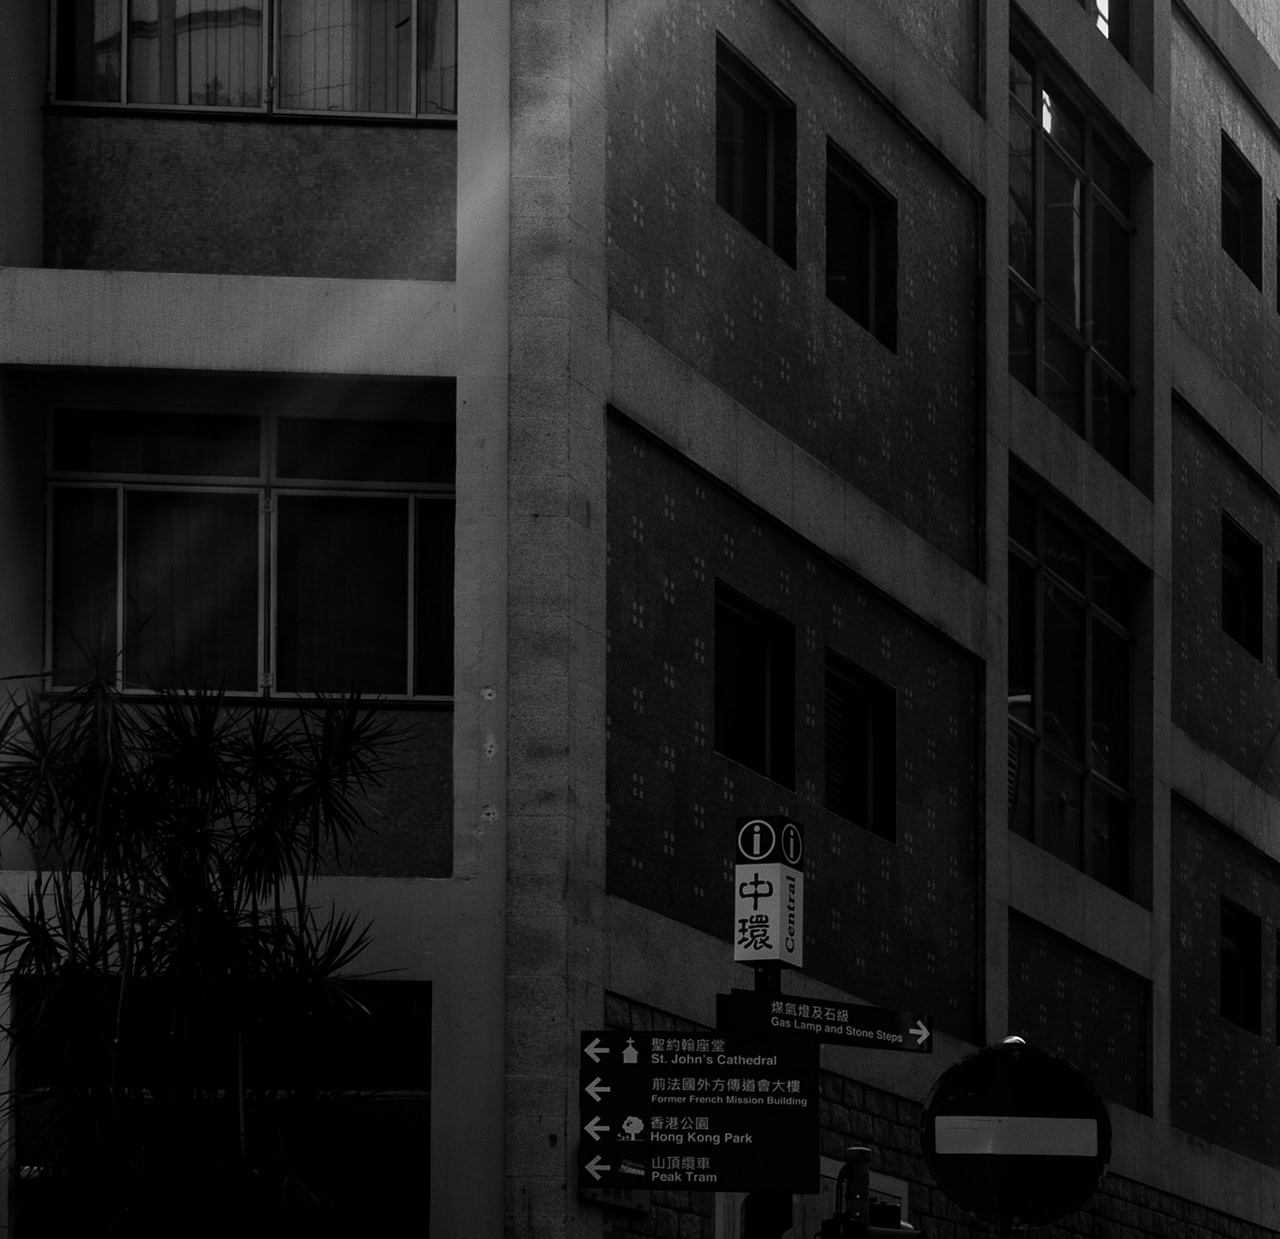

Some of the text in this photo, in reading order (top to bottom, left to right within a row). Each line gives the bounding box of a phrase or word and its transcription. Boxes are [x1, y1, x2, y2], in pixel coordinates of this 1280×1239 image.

[738, 873, 773, 950] 中環
[785, 875, 796, 953] Central
[771, 1000, 849, 1022] 煤氣燈及石級
[771, 1016, 903, 1043] Gas Lamp and Stone Steps
[651, 1038, 725, 1052] 聖約翰座堂
[651, 1054, 777, 1066] St. John's Cathedral
[652, 1077, 801, 1093] 前法國外方傳道會大樓
[652, 1095, 808, 1107] Former French Mission Building
[650, 1116, 709, 1130] 香港公園
[650, 1132, 753, 1145] Hong Kong Park
[652, 1156, 710, 1170] 山頂纜車
[652, 1171, 718, 1182] Peak Tram
